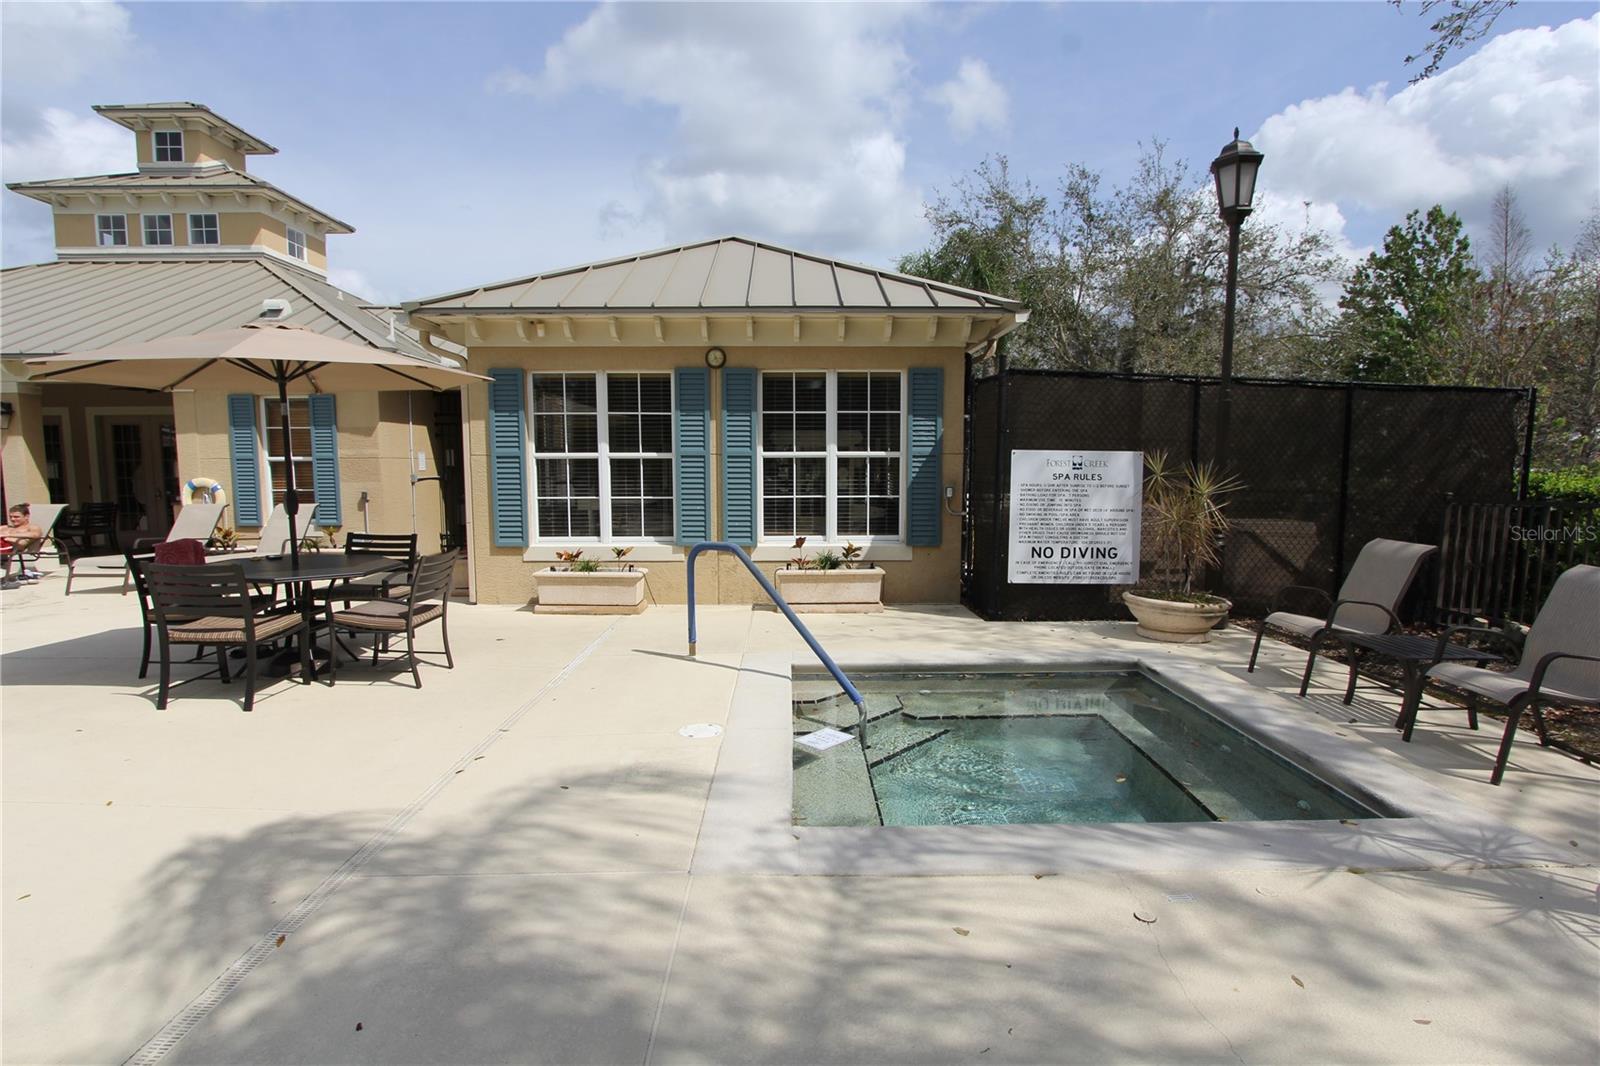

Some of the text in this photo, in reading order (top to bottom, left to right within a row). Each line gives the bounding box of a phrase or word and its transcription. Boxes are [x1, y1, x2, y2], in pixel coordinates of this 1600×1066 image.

[1084, 459, 1109, 468] CREEK
[1052, 473, 1103, 481] SPA RULES
[1031, 546, 1118, 560] NO DIVING
